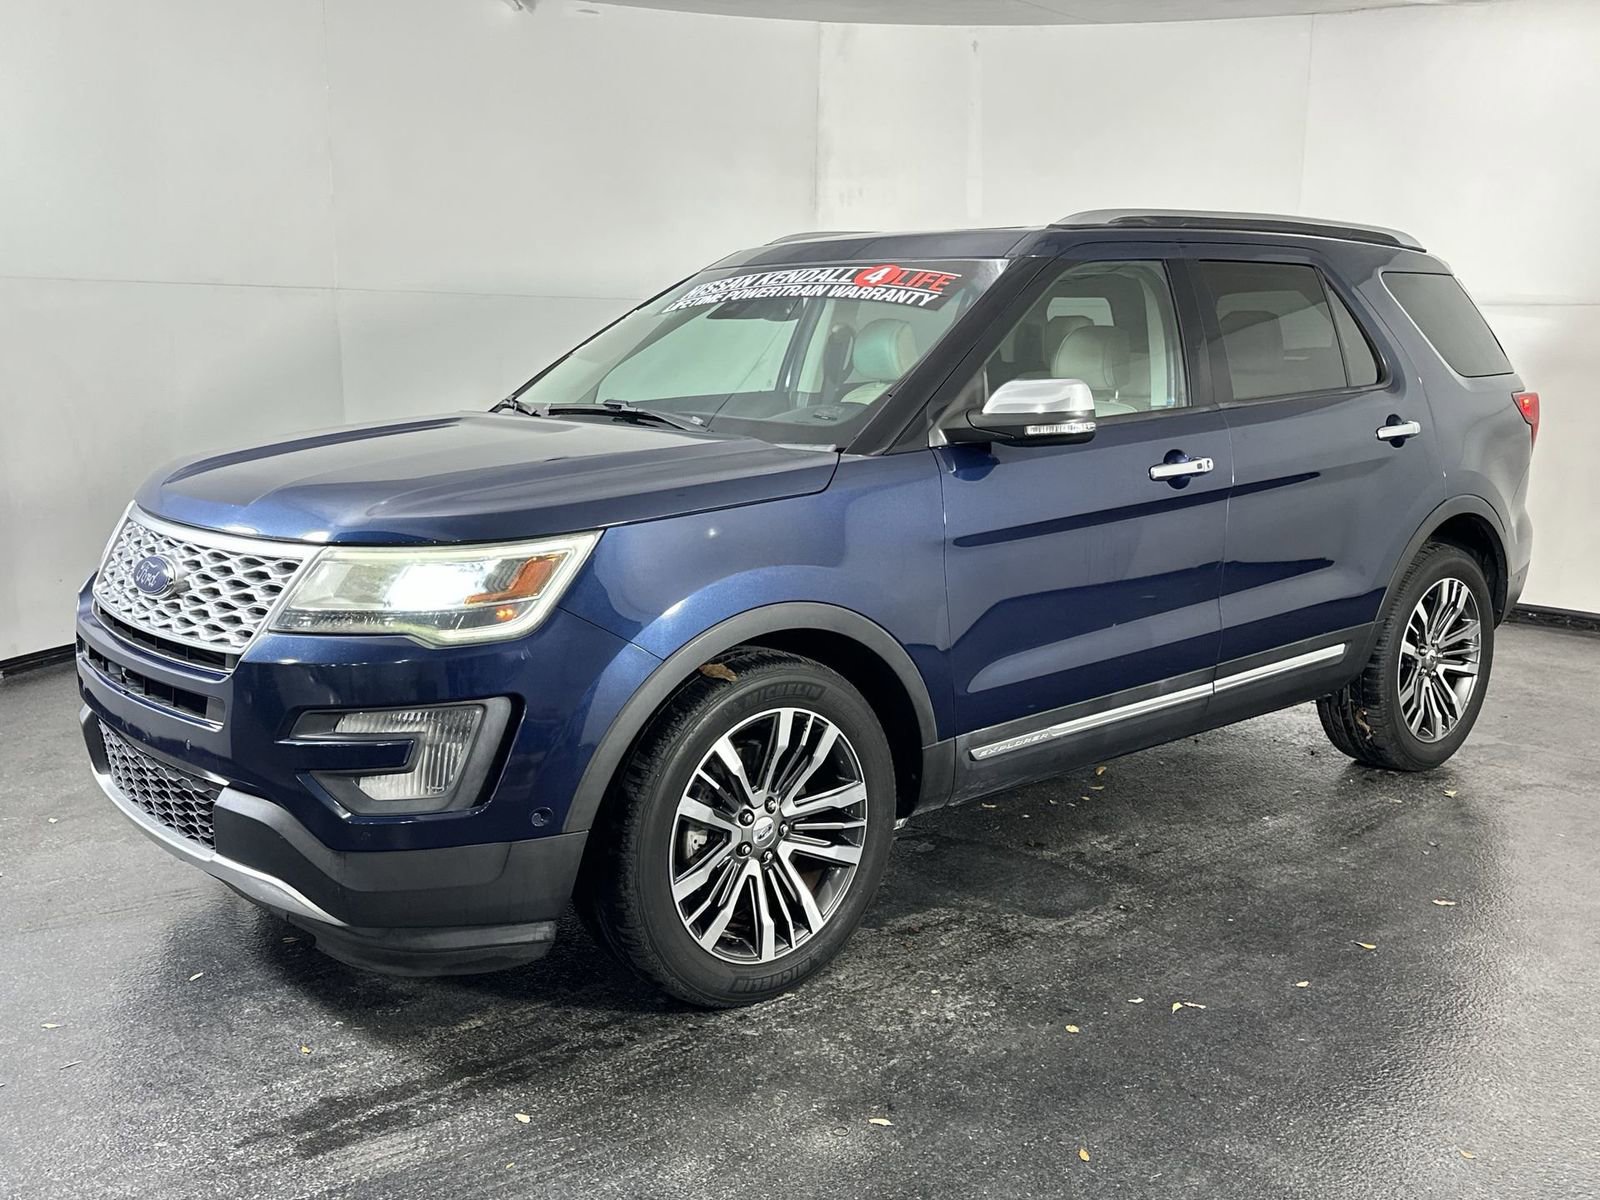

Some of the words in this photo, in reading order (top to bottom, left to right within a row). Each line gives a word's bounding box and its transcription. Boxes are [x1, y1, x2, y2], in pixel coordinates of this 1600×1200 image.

[680, 273, 759, 301] NISSAN
[755, 268, 857, 287] KENDALL
[864, 267, 891, 284] 4
[892, 269, 957, 292] LIFE
[661, 293, 724, 314] LIFETIME
[721, 284, 827, 302] POWERTRAIN
[826, 284, 939, 307] WARRANTY
[135, 560, 161, 588] Ford
[978, 733, 1049, 757] EXPLORER
